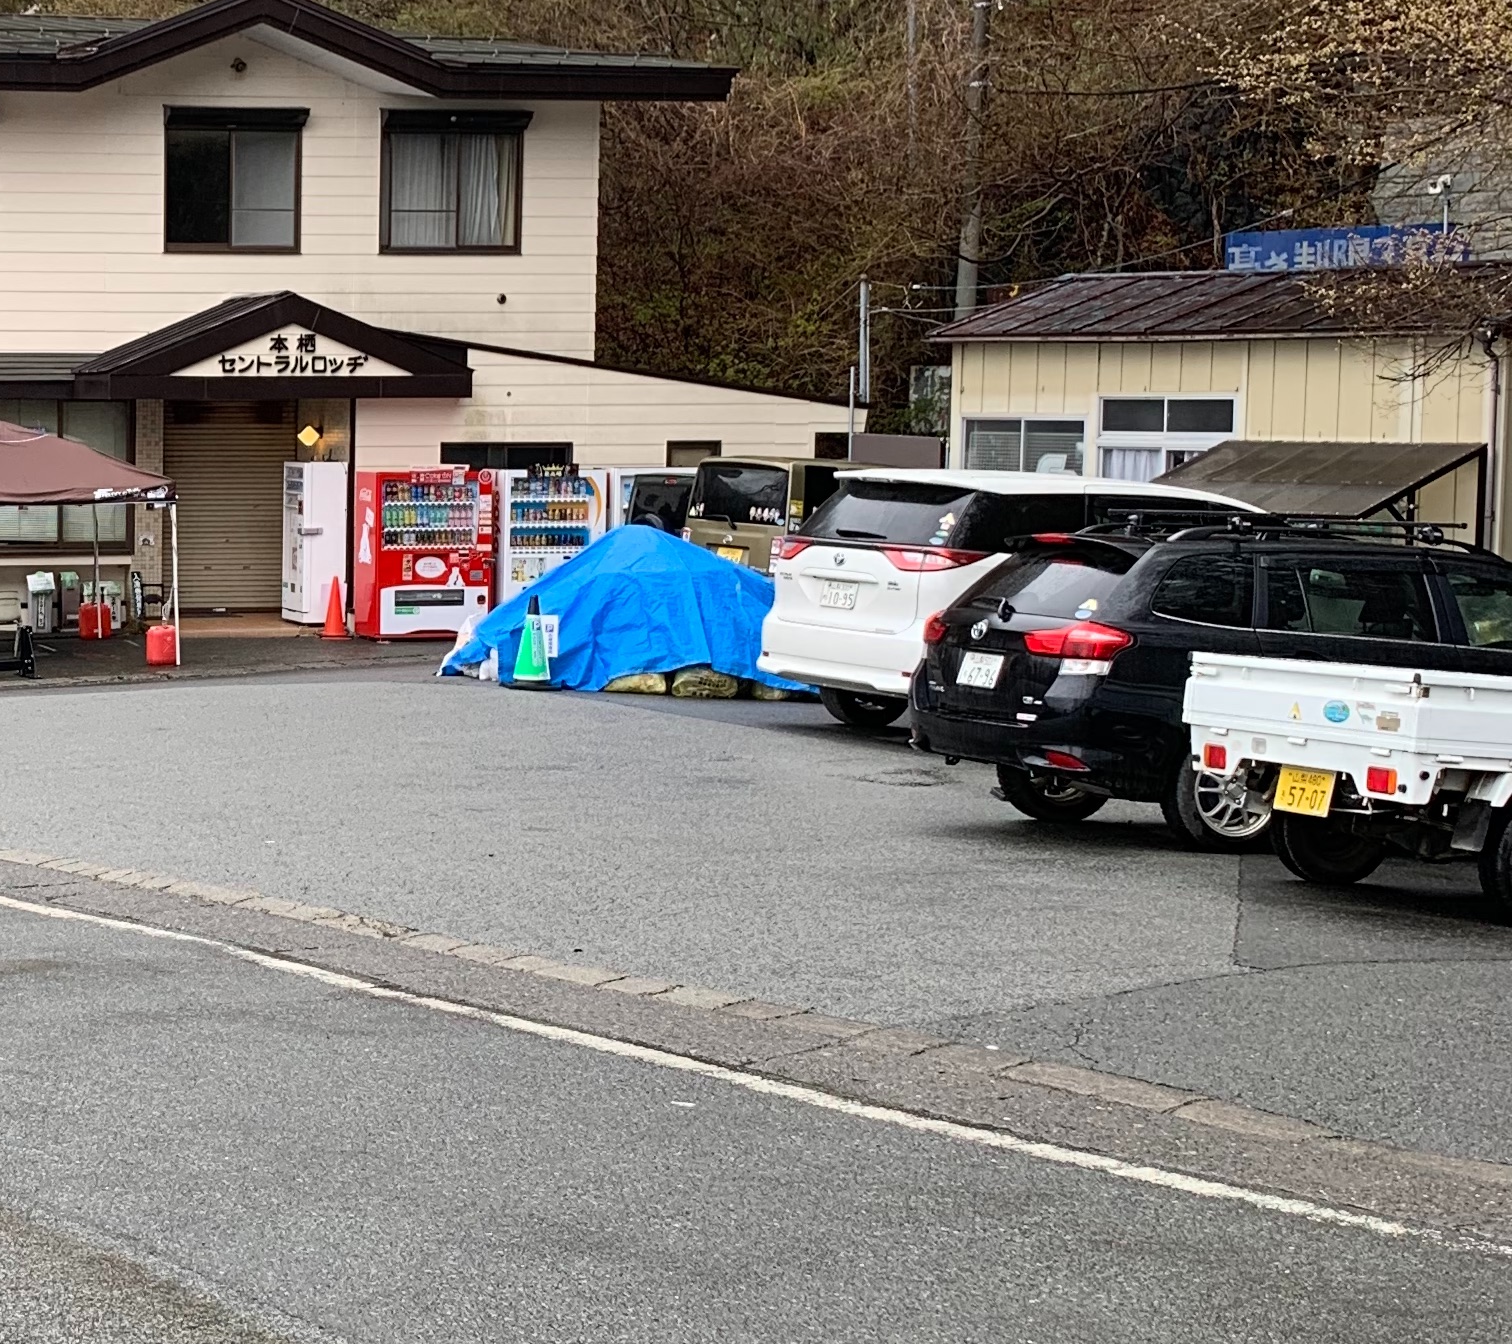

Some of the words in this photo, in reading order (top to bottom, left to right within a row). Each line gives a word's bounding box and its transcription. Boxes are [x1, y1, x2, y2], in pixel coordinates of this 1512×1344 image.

[269, 333, 317, 353] 本栖
[218, 355, 369, 374] セントラルロッヂ
